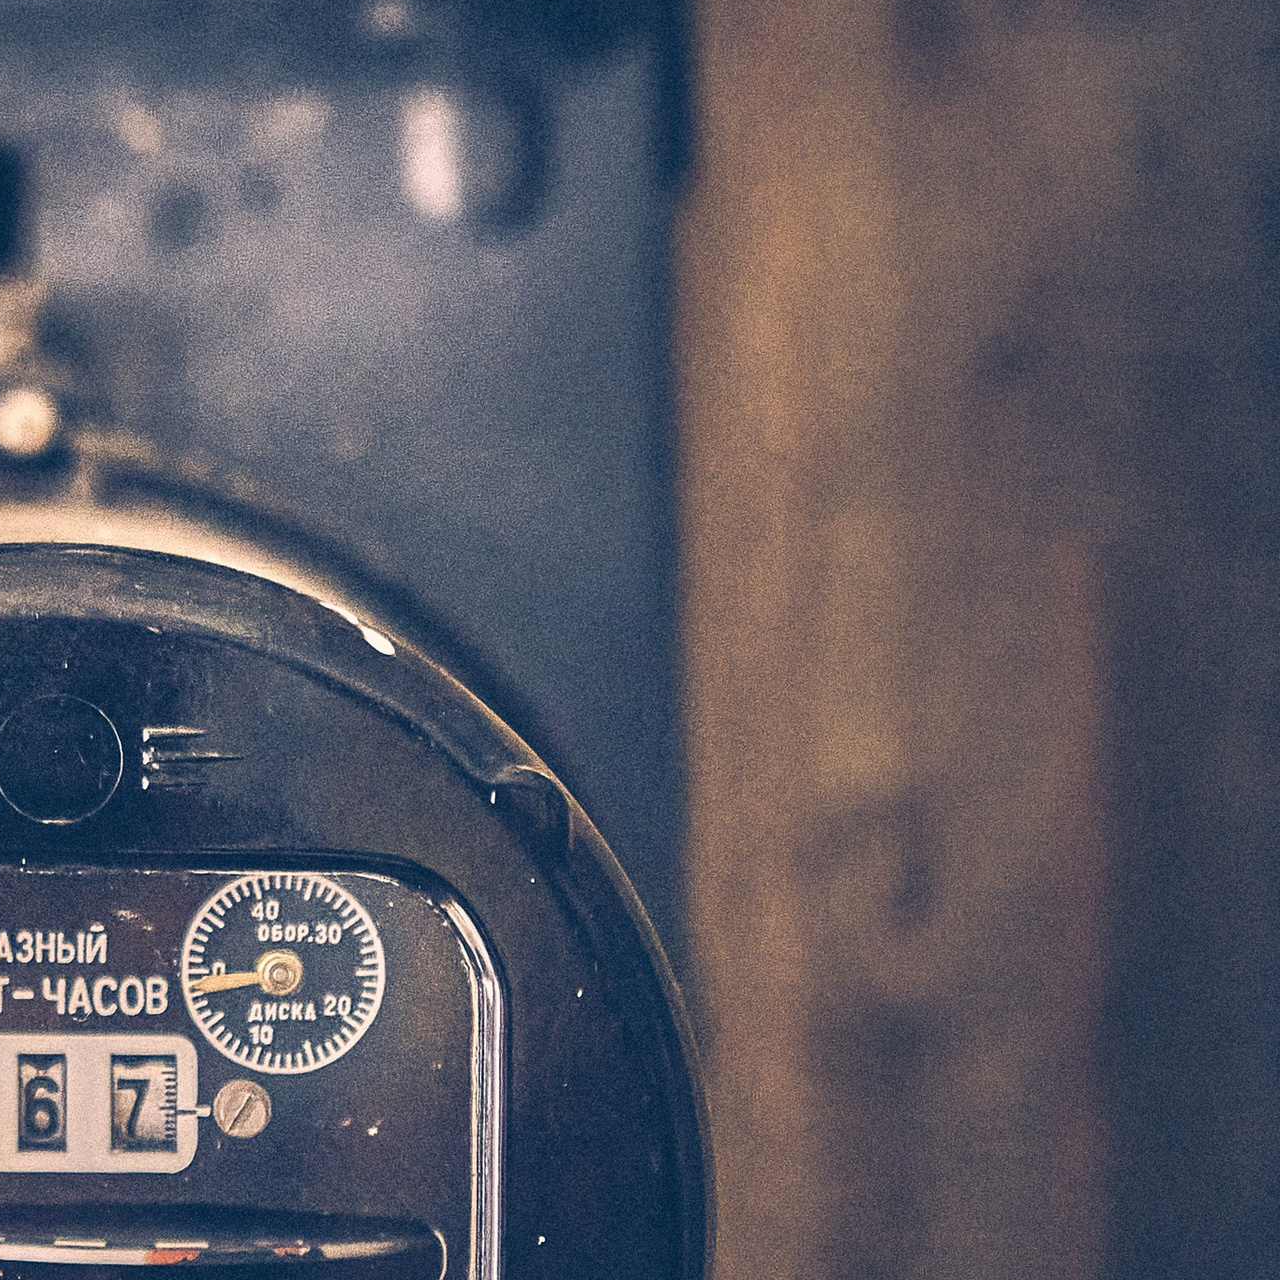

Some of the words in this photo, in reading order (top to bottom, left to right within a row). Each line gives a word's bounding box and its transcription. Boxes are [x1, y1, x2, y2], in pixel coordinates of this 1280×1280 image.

[251, 900, 279, 920] 40
[257, 925, 313, 942] ОБОР.
[314, 925, 342, 944] 30
[248, 1002, 317, 1021] ДИСКА
[323, 995, 351, 1016] 20
[248, 1024, 273, 1045] 10
